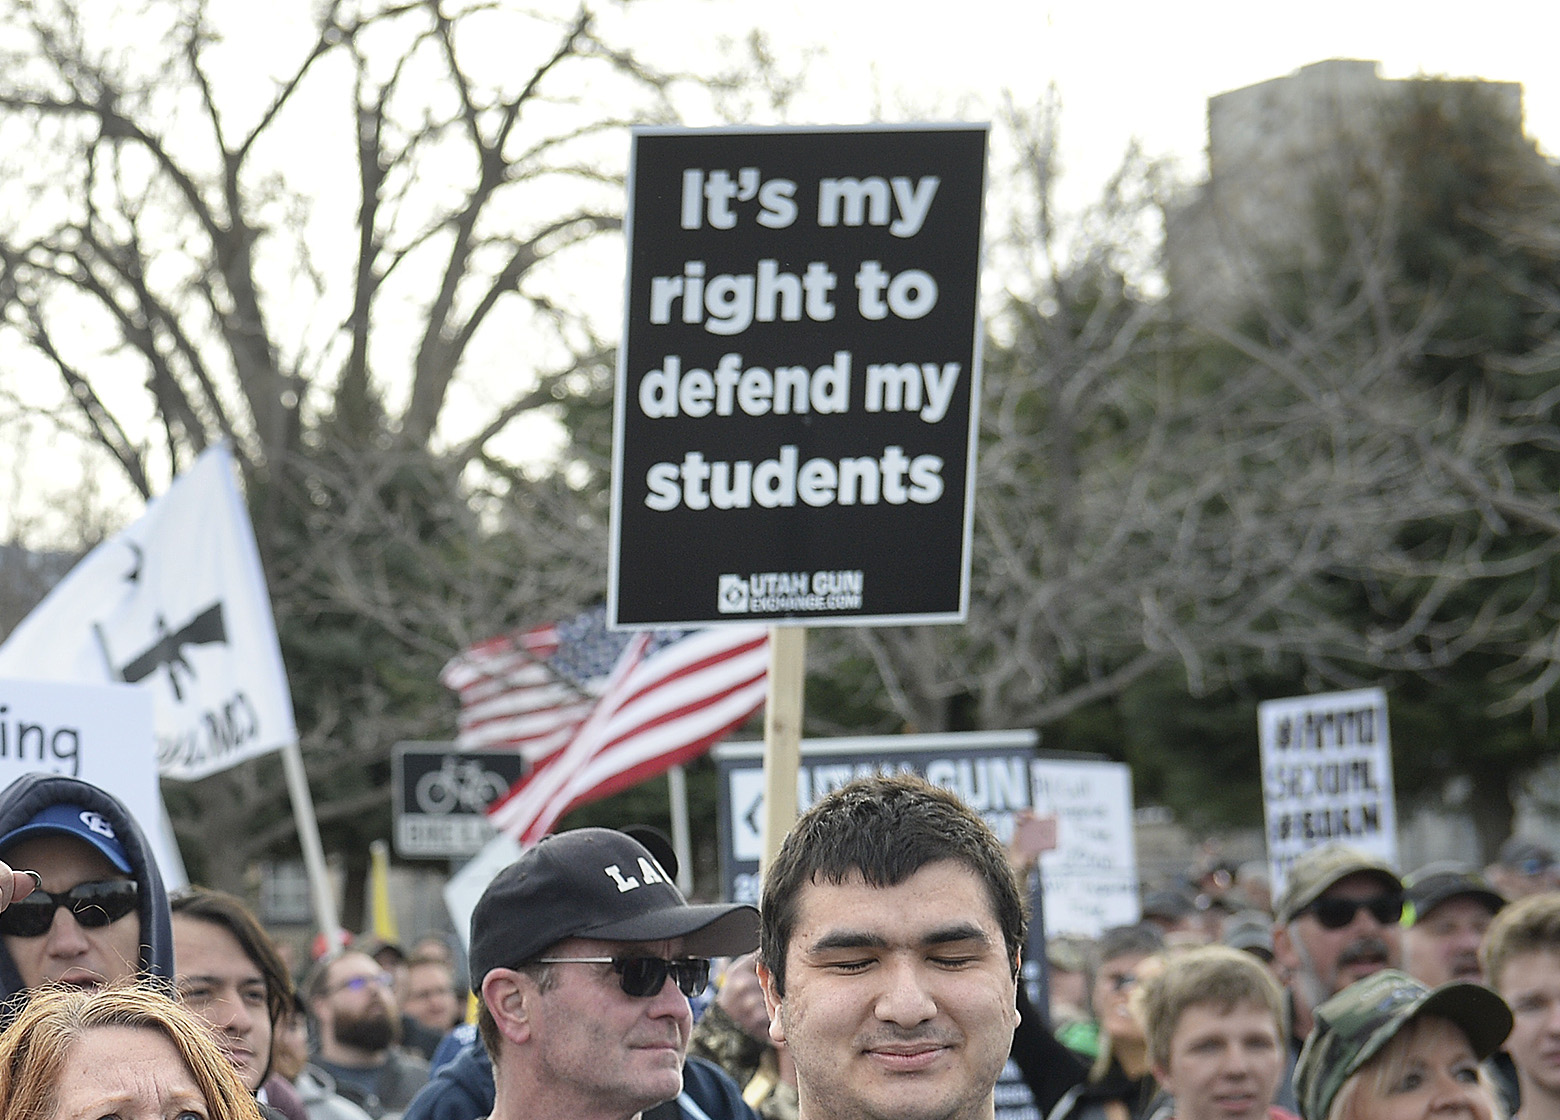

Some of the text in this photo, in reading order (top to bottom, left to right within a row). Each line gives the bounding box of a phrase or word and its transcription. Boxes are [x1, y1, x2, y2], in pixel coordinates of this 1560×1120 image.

[681, 167, 939, 238] It's my
[649, 260, 937, 335] right to
[639, 351, 961, 422] defend my
[645, 445, 944, 510] students
[750, 570, 864, 597] UTAH GUN
